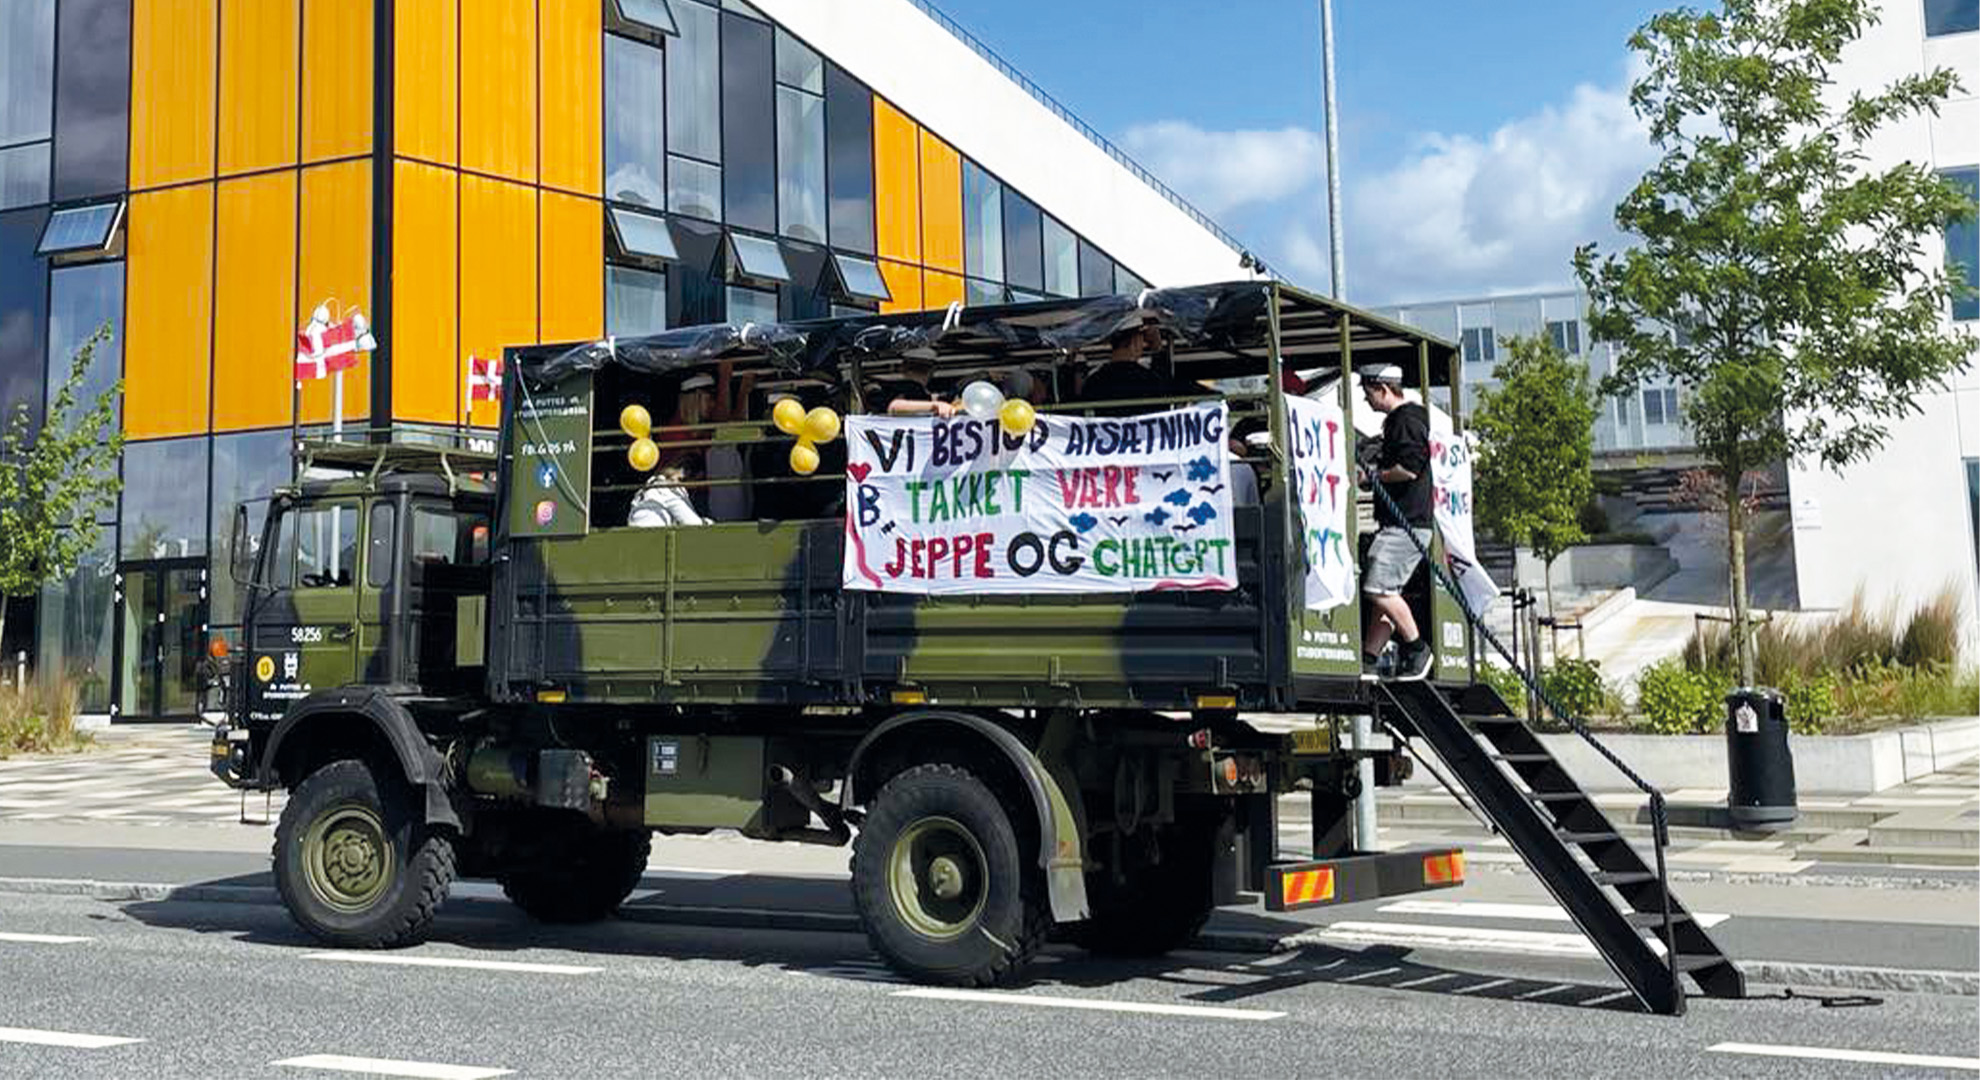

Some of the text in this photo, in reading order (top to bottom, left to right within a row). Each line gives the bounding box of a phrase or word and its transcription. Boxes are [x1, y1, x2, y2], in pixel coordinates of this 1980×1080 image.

[1065, 408, 1223, 456] AFSÆTNING
[905, 465, 1140, 524] TAKKET VÆRE
[885, 530, 1230, 579] JEPPE OG CHATGPT
